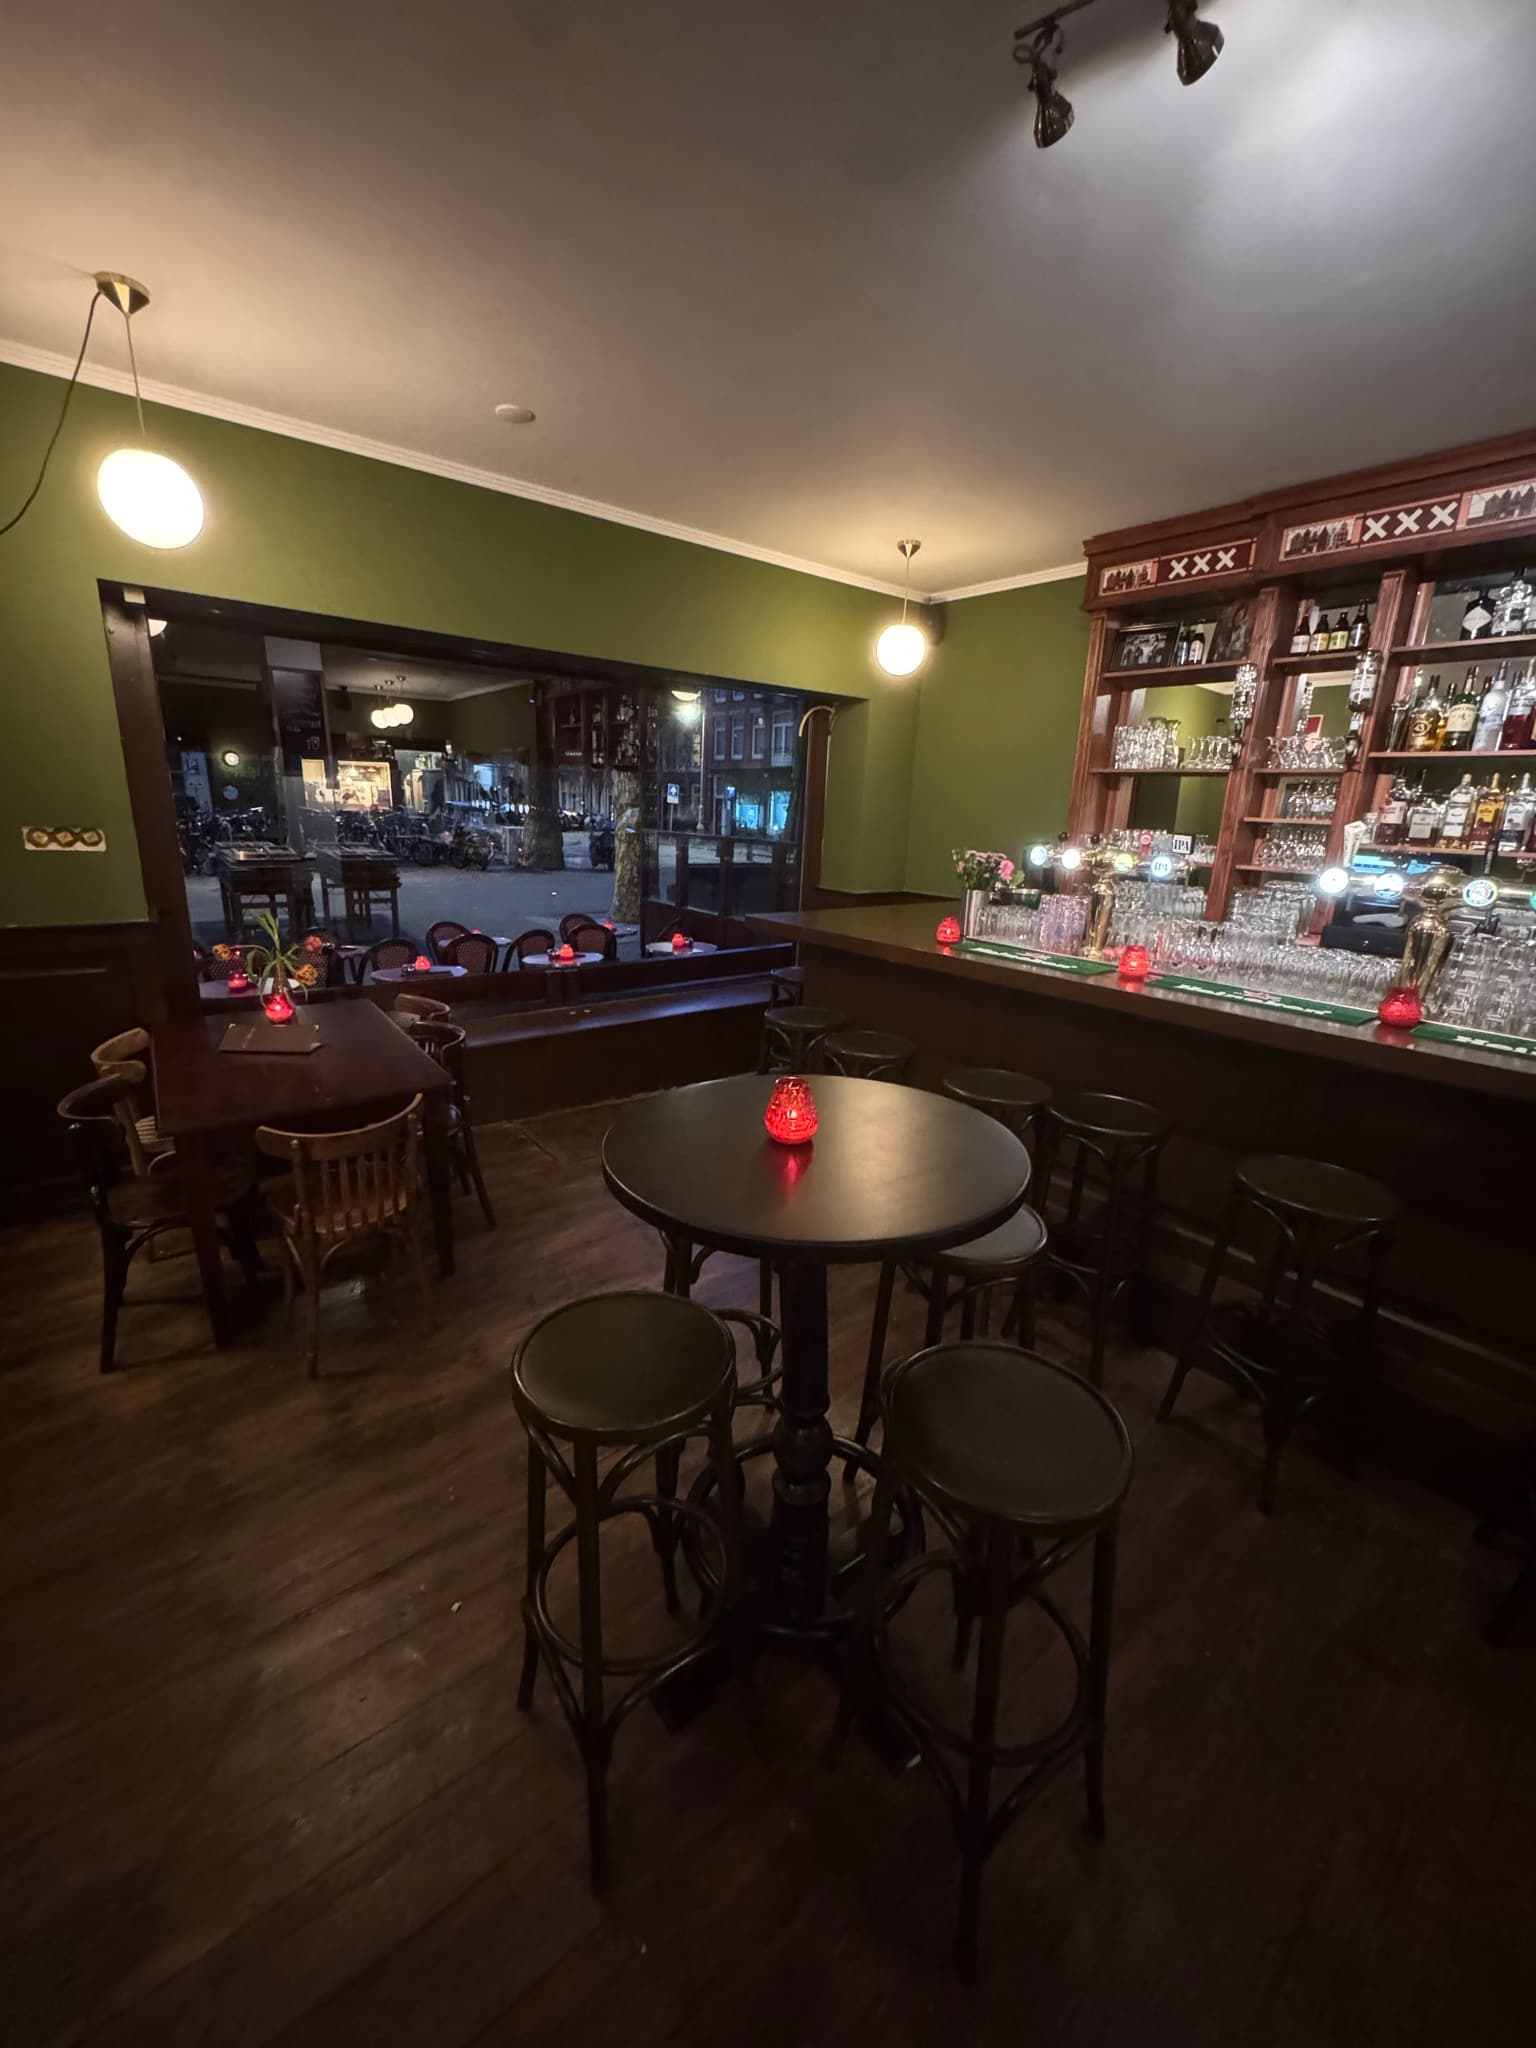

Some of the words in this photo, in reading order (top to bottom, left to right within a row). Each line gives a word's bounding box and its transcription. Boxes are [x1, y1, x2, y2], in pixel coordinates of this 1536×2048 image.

[1362, 501, 1459, 541] XXX
[1168, 547, 1237, 580] XXX
[1174, 839, 1190, 852] IPA
